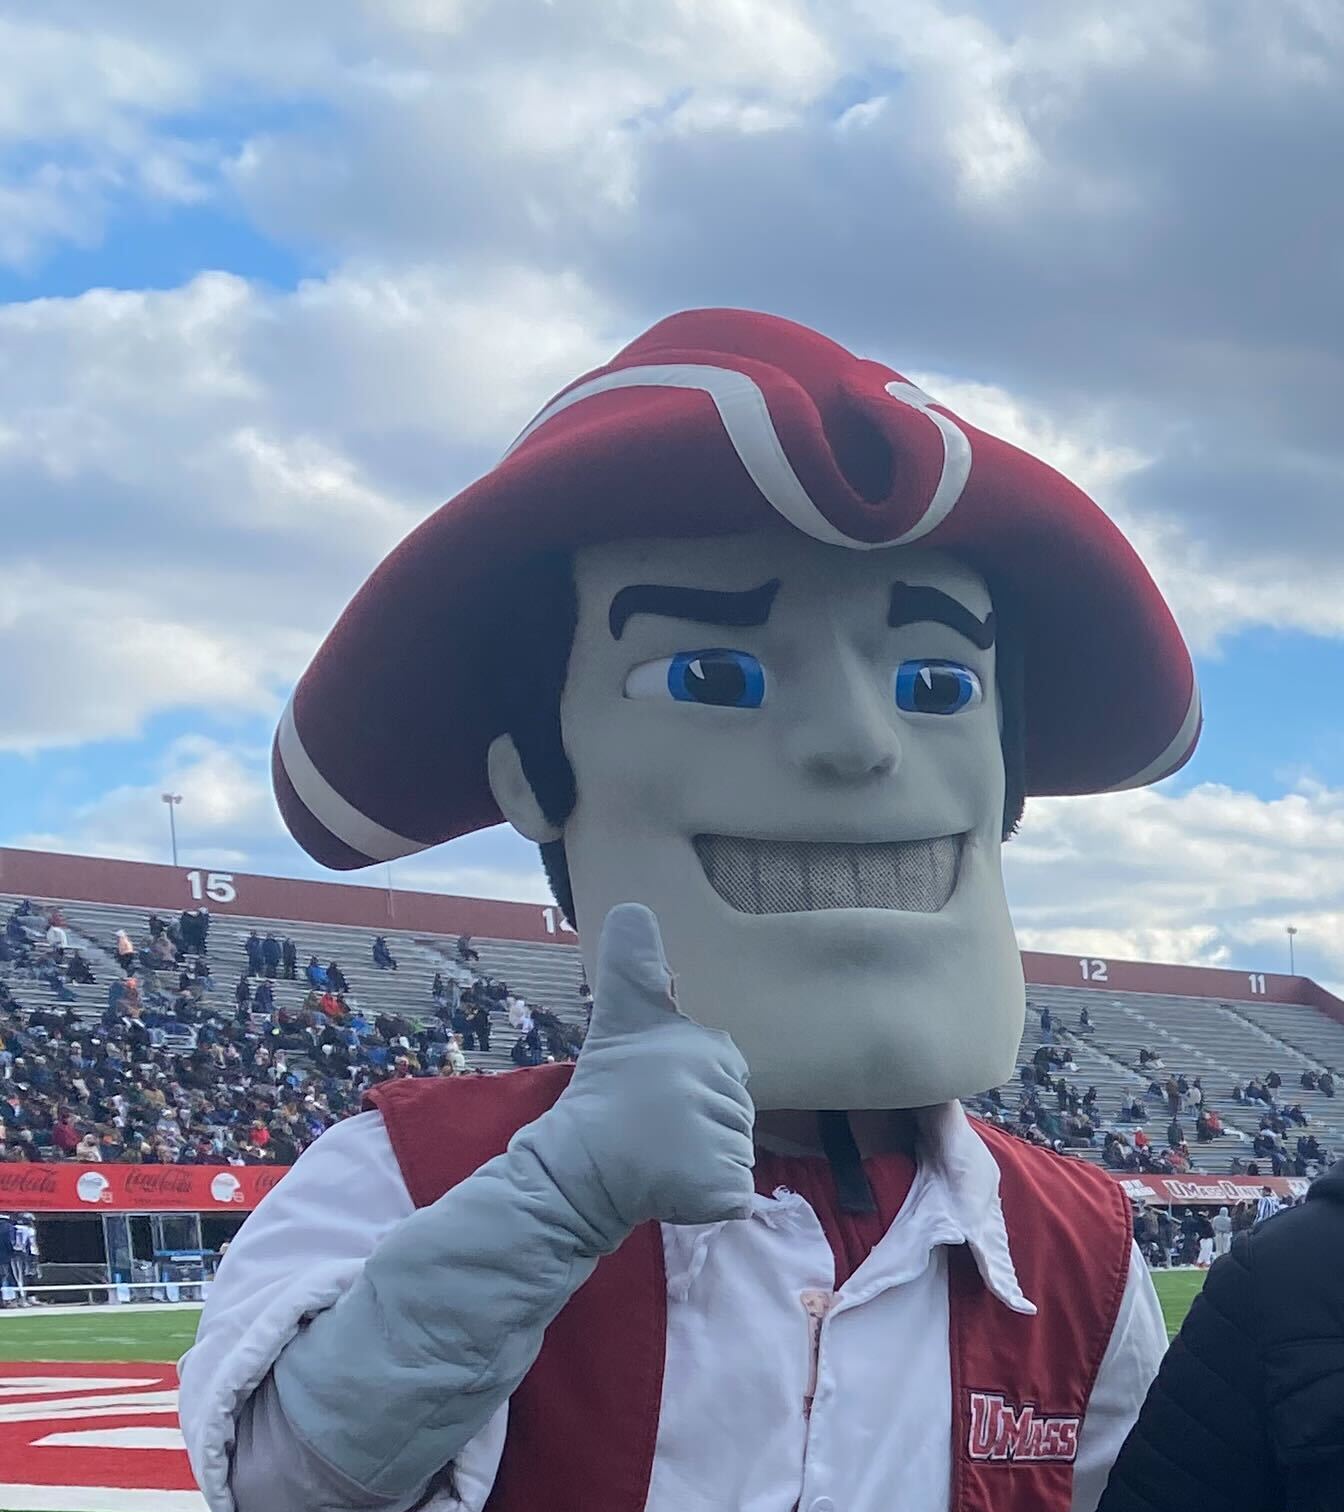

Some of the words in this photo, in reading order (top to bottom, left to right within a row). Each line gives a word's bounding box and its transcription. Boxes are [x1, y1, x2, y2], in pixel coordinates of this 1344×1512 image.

[186, 870, 237, 902] 15
[1079, 959, 1108, 982] 12
[1248, 974, 1266, 995] 11
